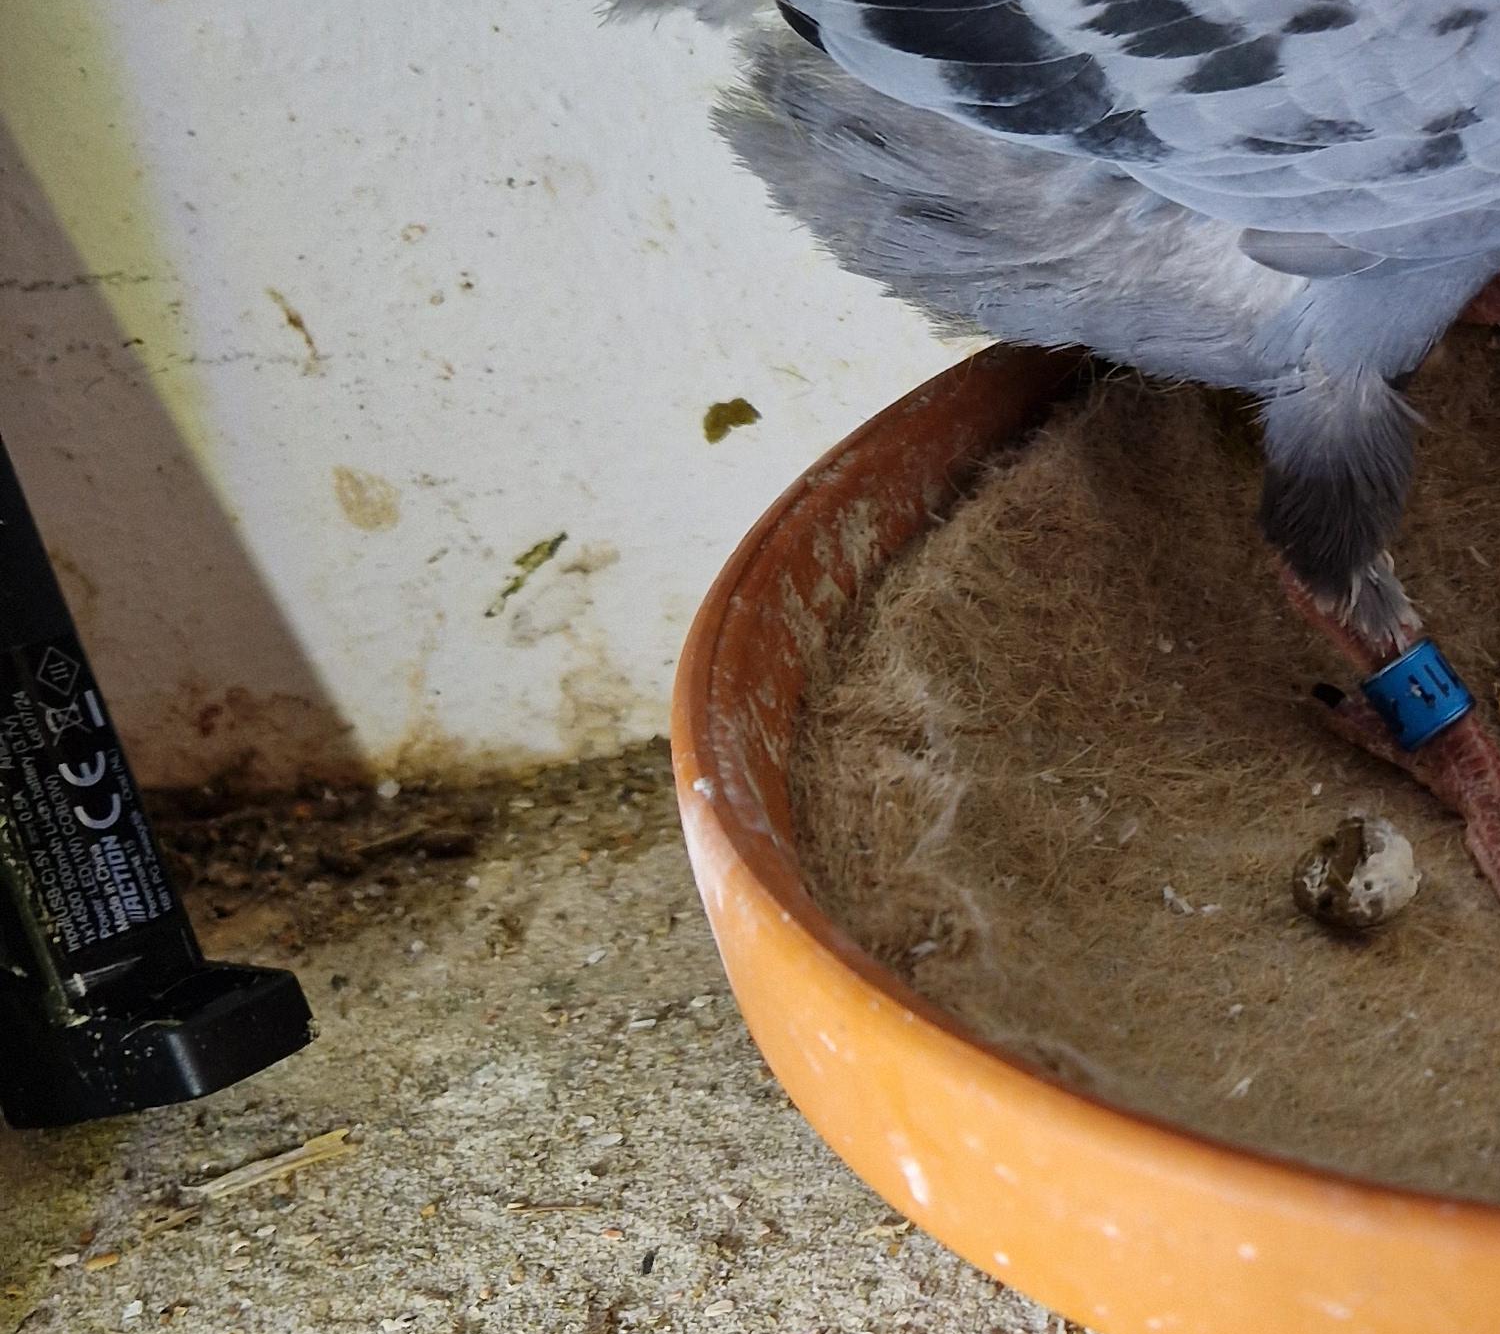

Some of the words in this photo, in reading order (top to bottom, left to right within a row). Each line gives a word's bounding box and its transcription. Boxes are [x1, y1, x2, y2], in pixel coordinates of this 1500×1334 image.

[9, 688, 38, 728] 07/24
[25, 726, 46, 750] Lot
[16, 753, 48, 800] battery
[57, 748, 122, 830] CE
[42, 772, 80, 836] COB(3W)
[30, 846, 51, 868] 5V
[45, 835, 79, 891] 500mAh
[85, 842, 112, 882] China
[100, 880, 117, 896] in
[66, 889, 99, 945] 1x14500
[104, 894, 131, 933] Made
